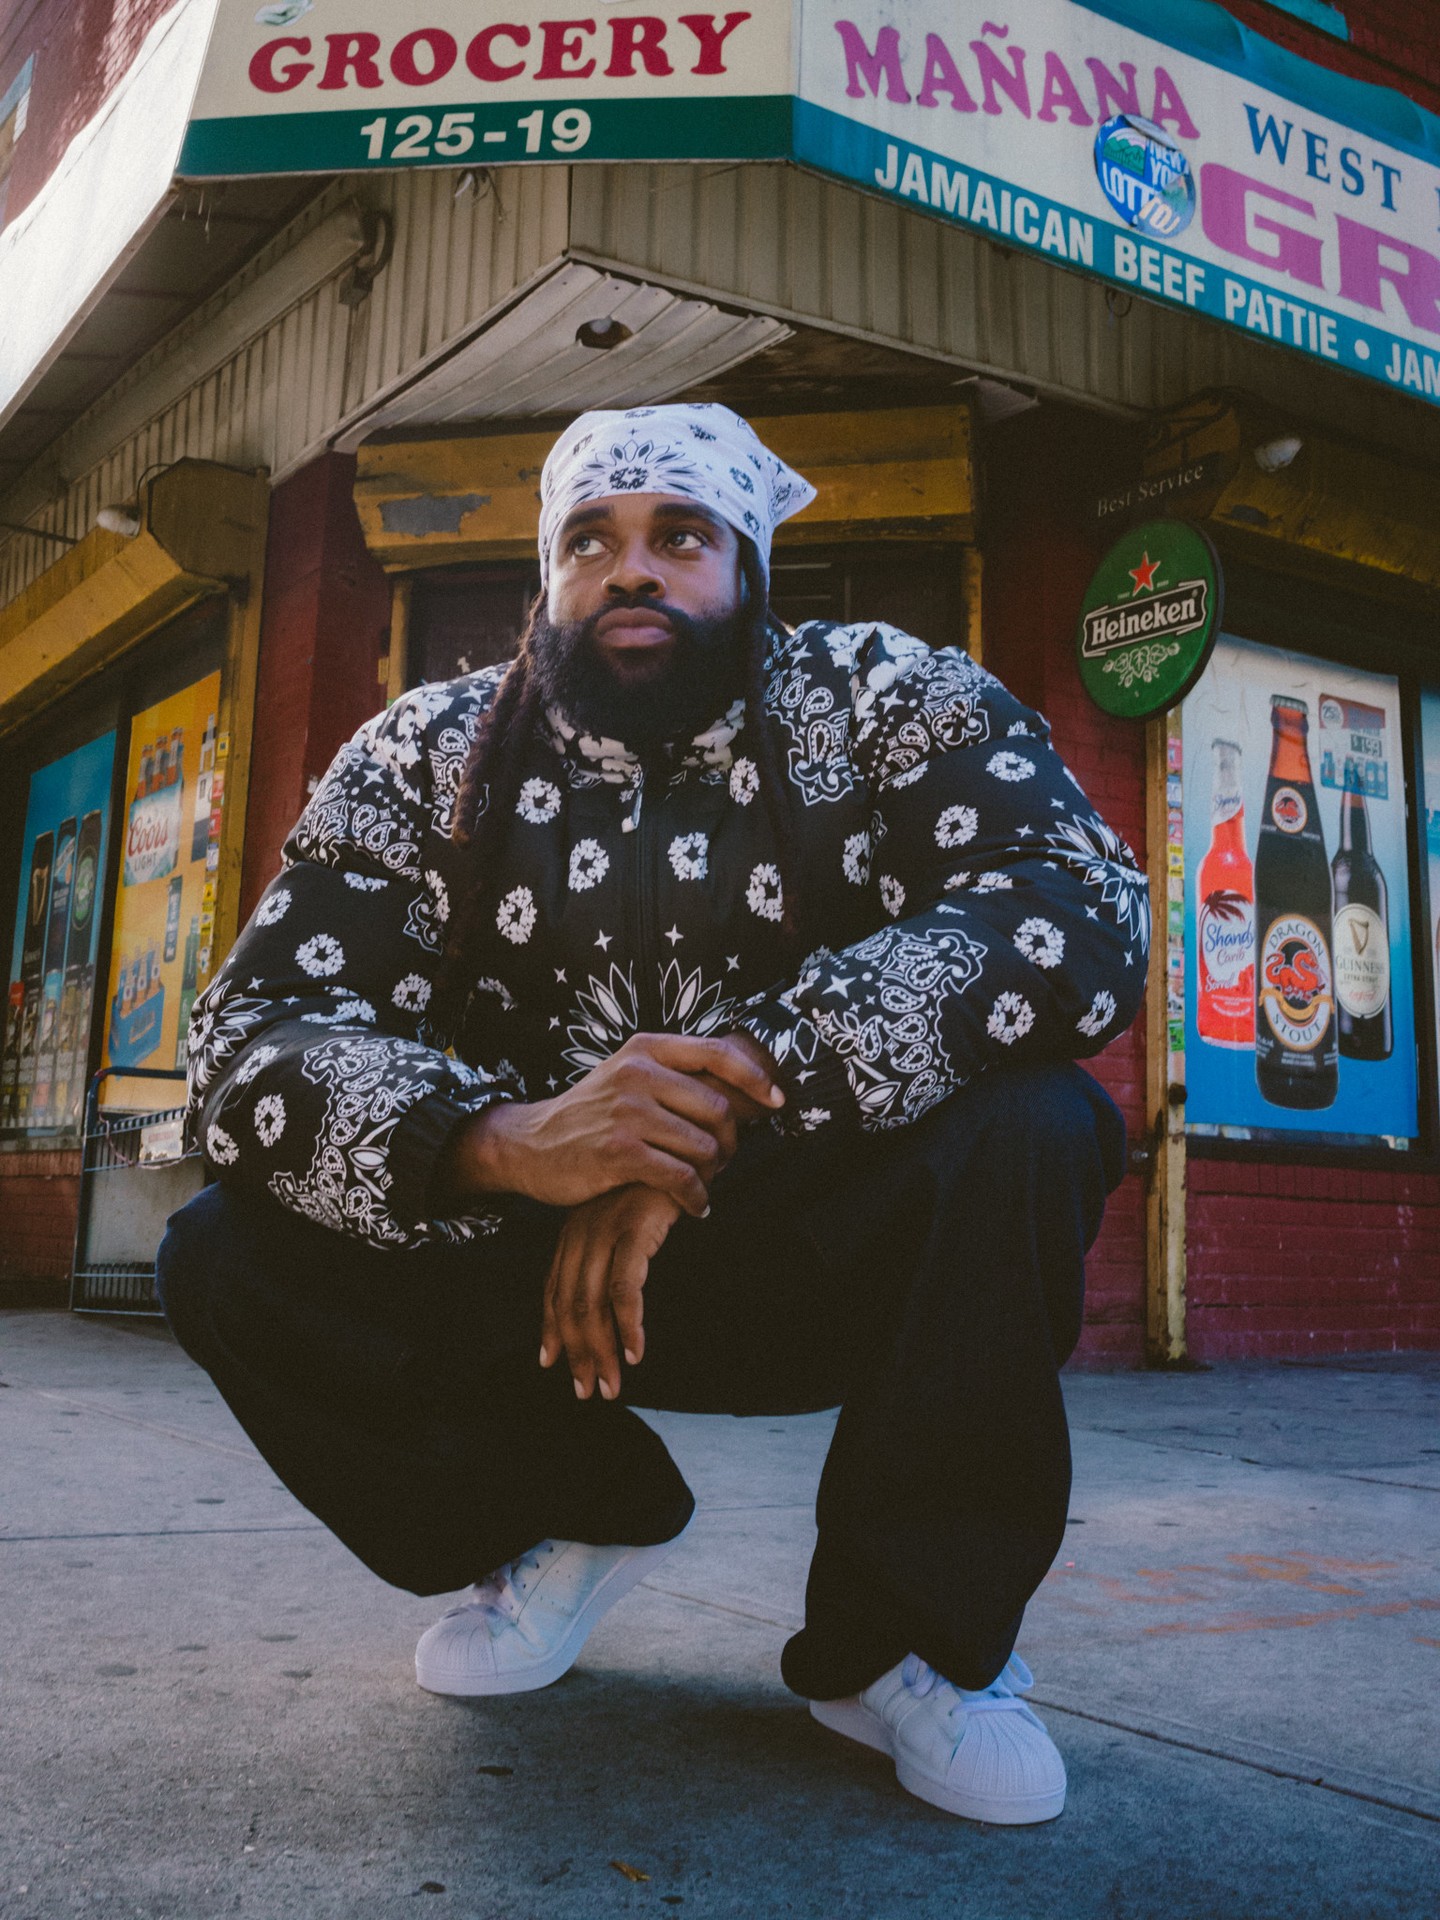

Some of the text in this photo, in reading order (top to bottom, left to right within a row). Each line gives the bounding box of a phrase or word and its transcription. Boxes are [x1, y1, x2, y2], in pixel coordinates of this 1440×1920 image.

[248, 11, 752, 94] GROCERY
[834, 20, 1200, 140] MAÑANA
[359, 107, 592, 160] 125-19
[1242, 102, 1402, 213] WEST
[875, 144, 1094, 268] JAMAICAN
[1114, 234, 1205, 306] BEEF
[1225, 278, 1338, 360] PATTIE
[1098, 465, 1204, 518] Best Service
[1091, 598, 1196, 646] Heineken
[128, 816, 168, 857] Coors
[134, 851, 158, 872] LIGHT
[1269, 922, 1324, 957] DRAGON
[1336, 956, 1385, 975] GUINNESS
[1274, 1013, 1321, 1042] STOUT
